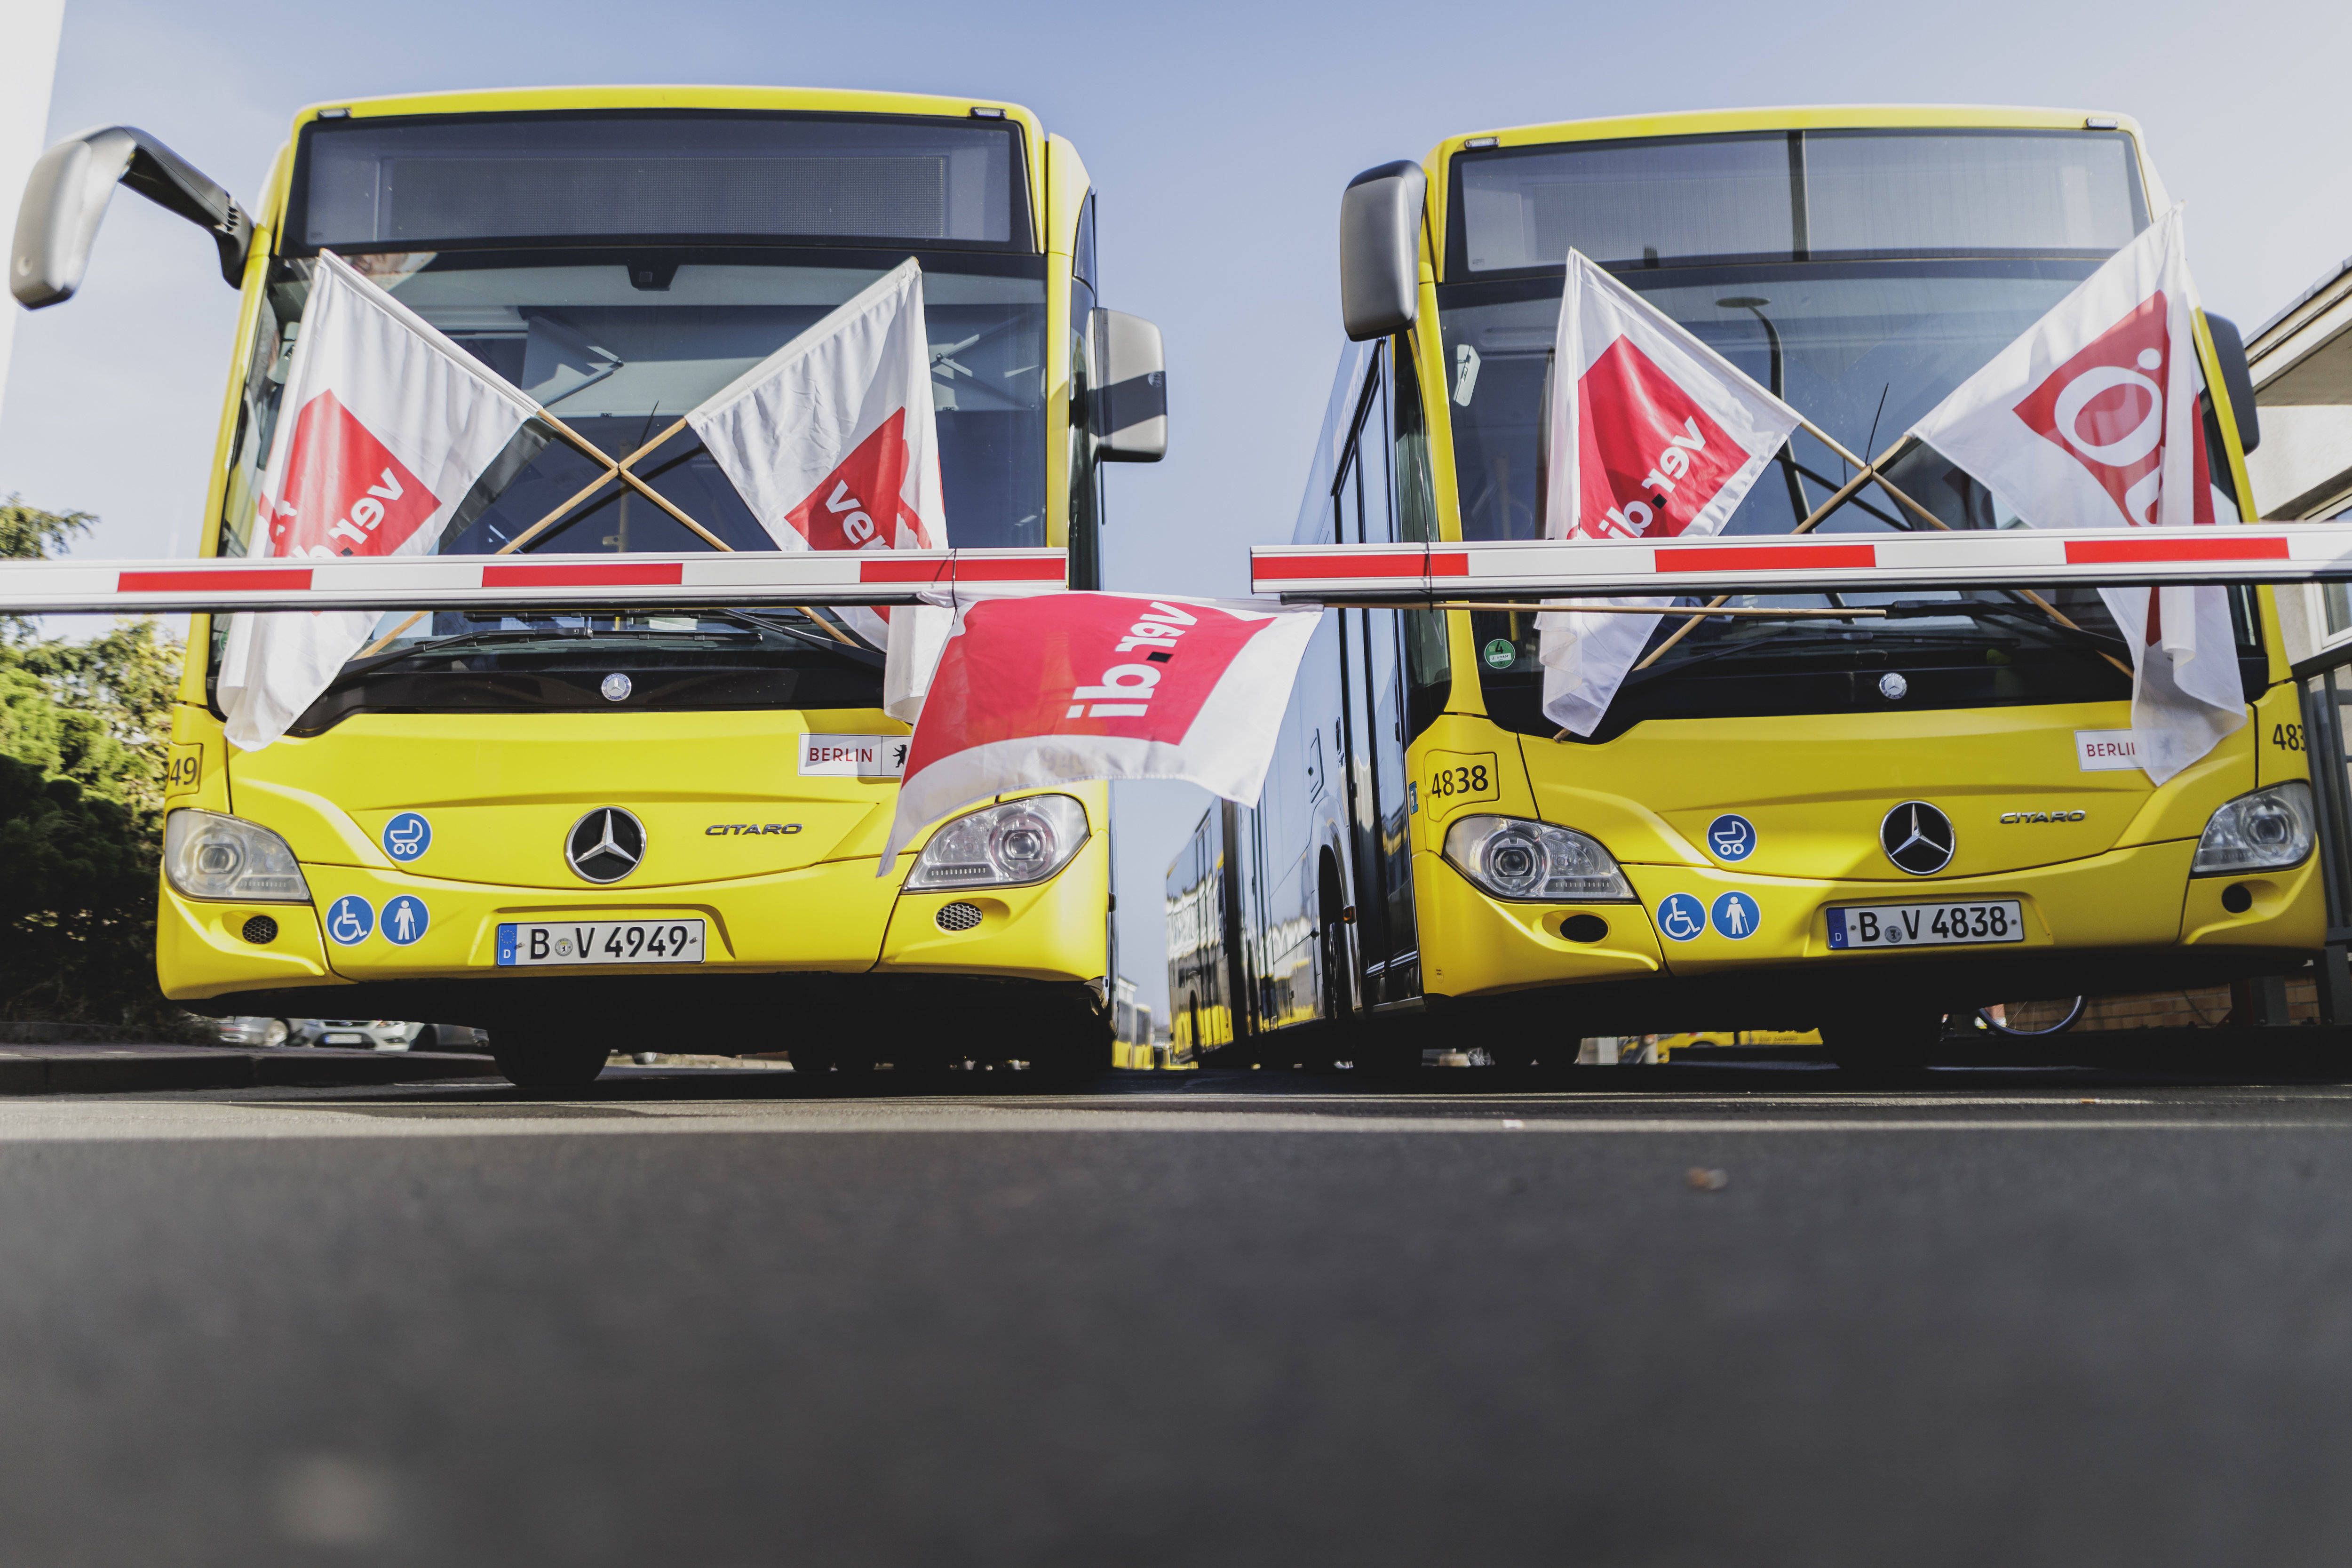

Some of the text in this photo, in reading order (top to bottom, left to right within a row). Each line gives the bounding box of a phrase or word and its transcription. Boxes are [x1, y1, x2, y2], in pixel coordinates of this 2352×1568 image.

[1495, 641, 1504, 653] 4
[809, 747, 873, 763] BERLIN
[1431, 765, 1488, 799] 4838
[2000, 810, 2086, 824] CITARO
[705, 823, 803, 836] CITARO
[1859, 906, 2008, 941] B V 4838
[530, 925, 688, 960] B V 4949
[1835, 932, 1842, 941] D
[503, 949, 511, 959] D
